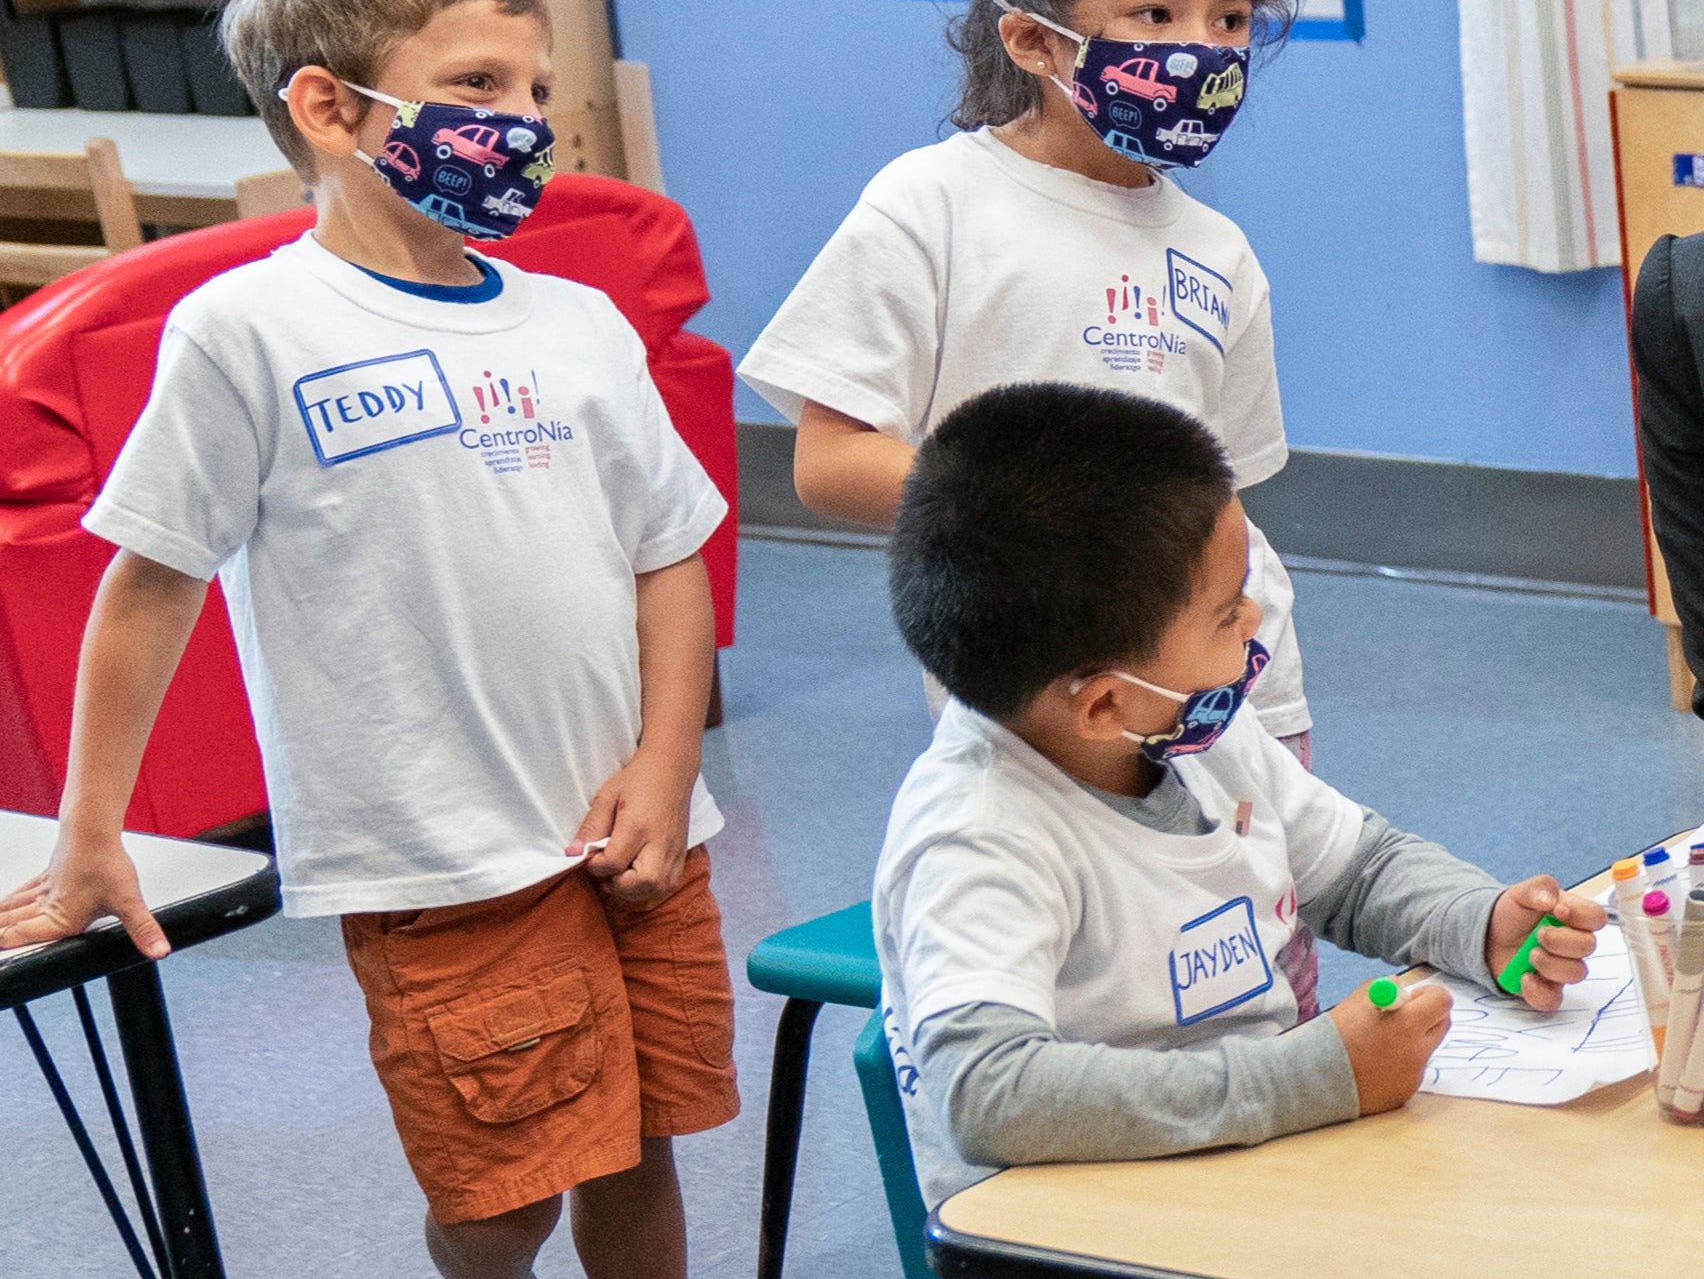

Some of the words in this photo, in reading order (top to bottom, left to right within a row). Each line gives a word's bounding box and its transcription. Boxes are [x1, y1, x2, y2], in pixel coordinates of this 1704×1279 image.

[438, 171, 468, 191] BEEP!
[305, 381, 425, 433] TEDDY
[1177, 927, 1257, 990] JAYDEN
